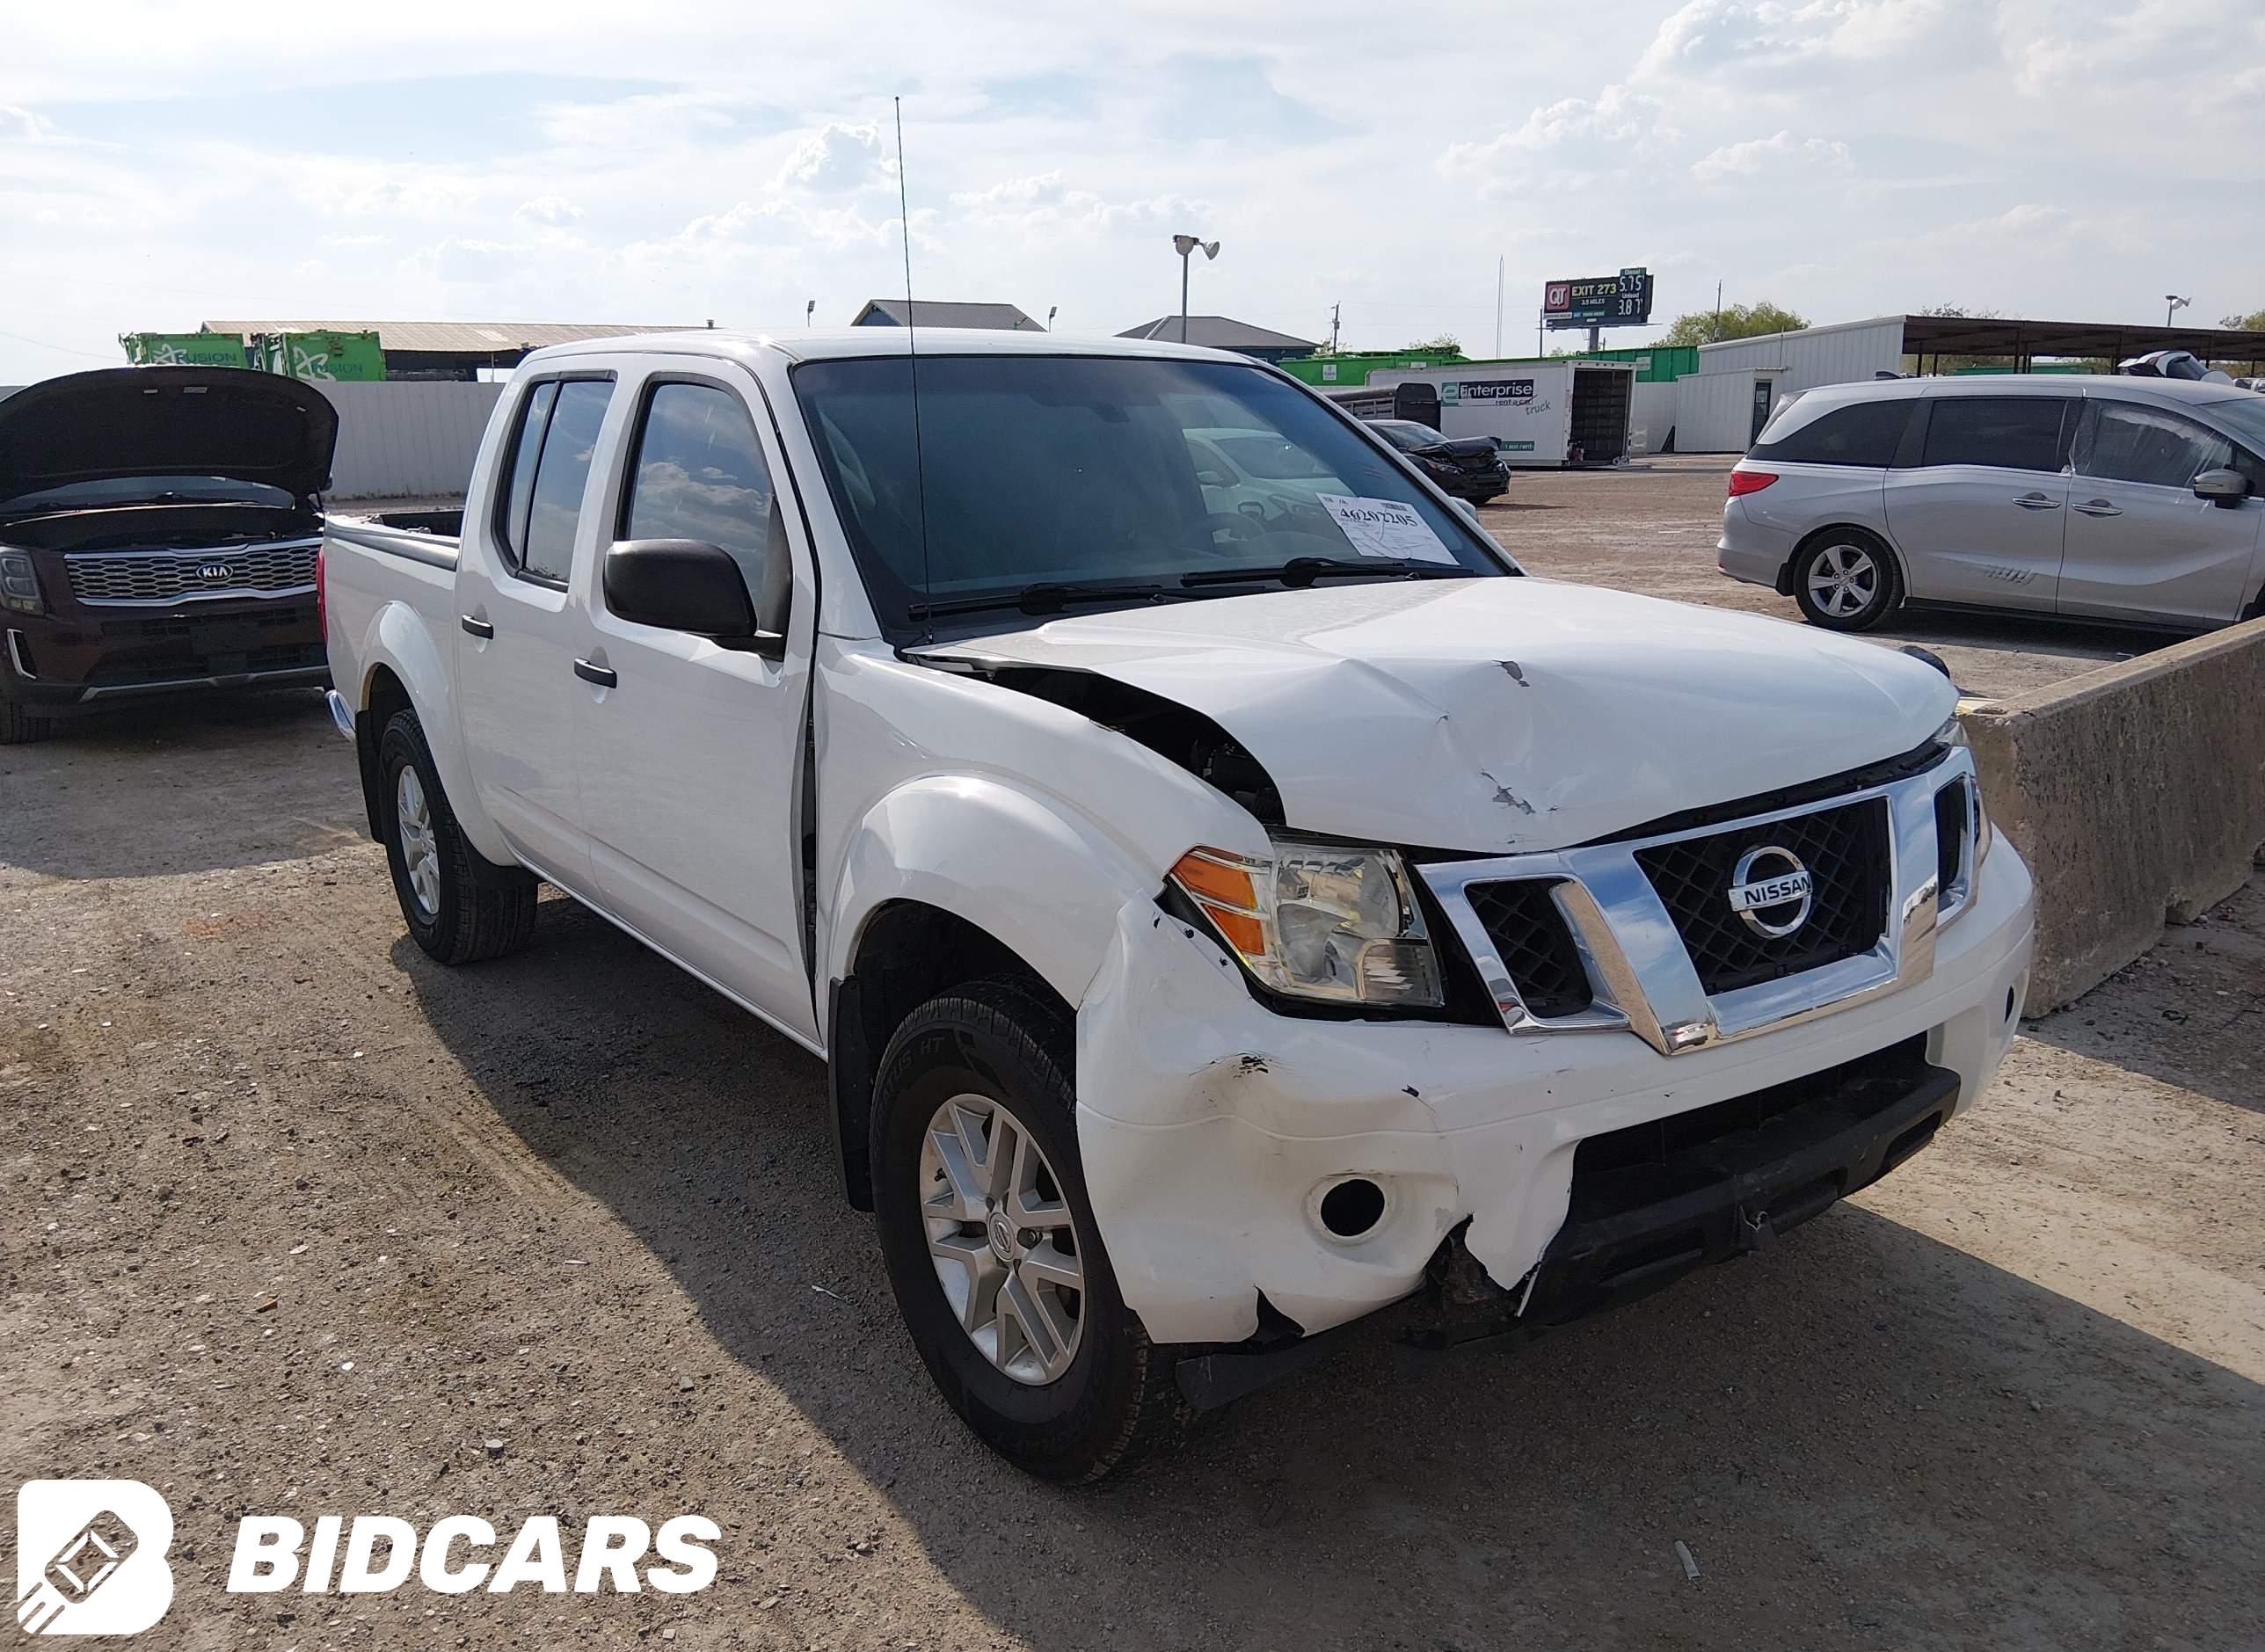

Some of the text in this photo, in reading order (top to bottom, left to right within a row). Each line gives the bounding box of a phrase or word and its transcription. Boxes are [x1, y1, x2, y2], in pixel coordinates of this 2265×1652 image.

[1549, 287, 1566, 305] QT
[1572, 283, 1616, 296] EXIT 273
[1460, 382, 1533, 398] Enterprise
[1526, 400, 1551, 416] truck
[202, 566, 229, 578] KIA
[1744, 876, 1811, 905] NISSAN
